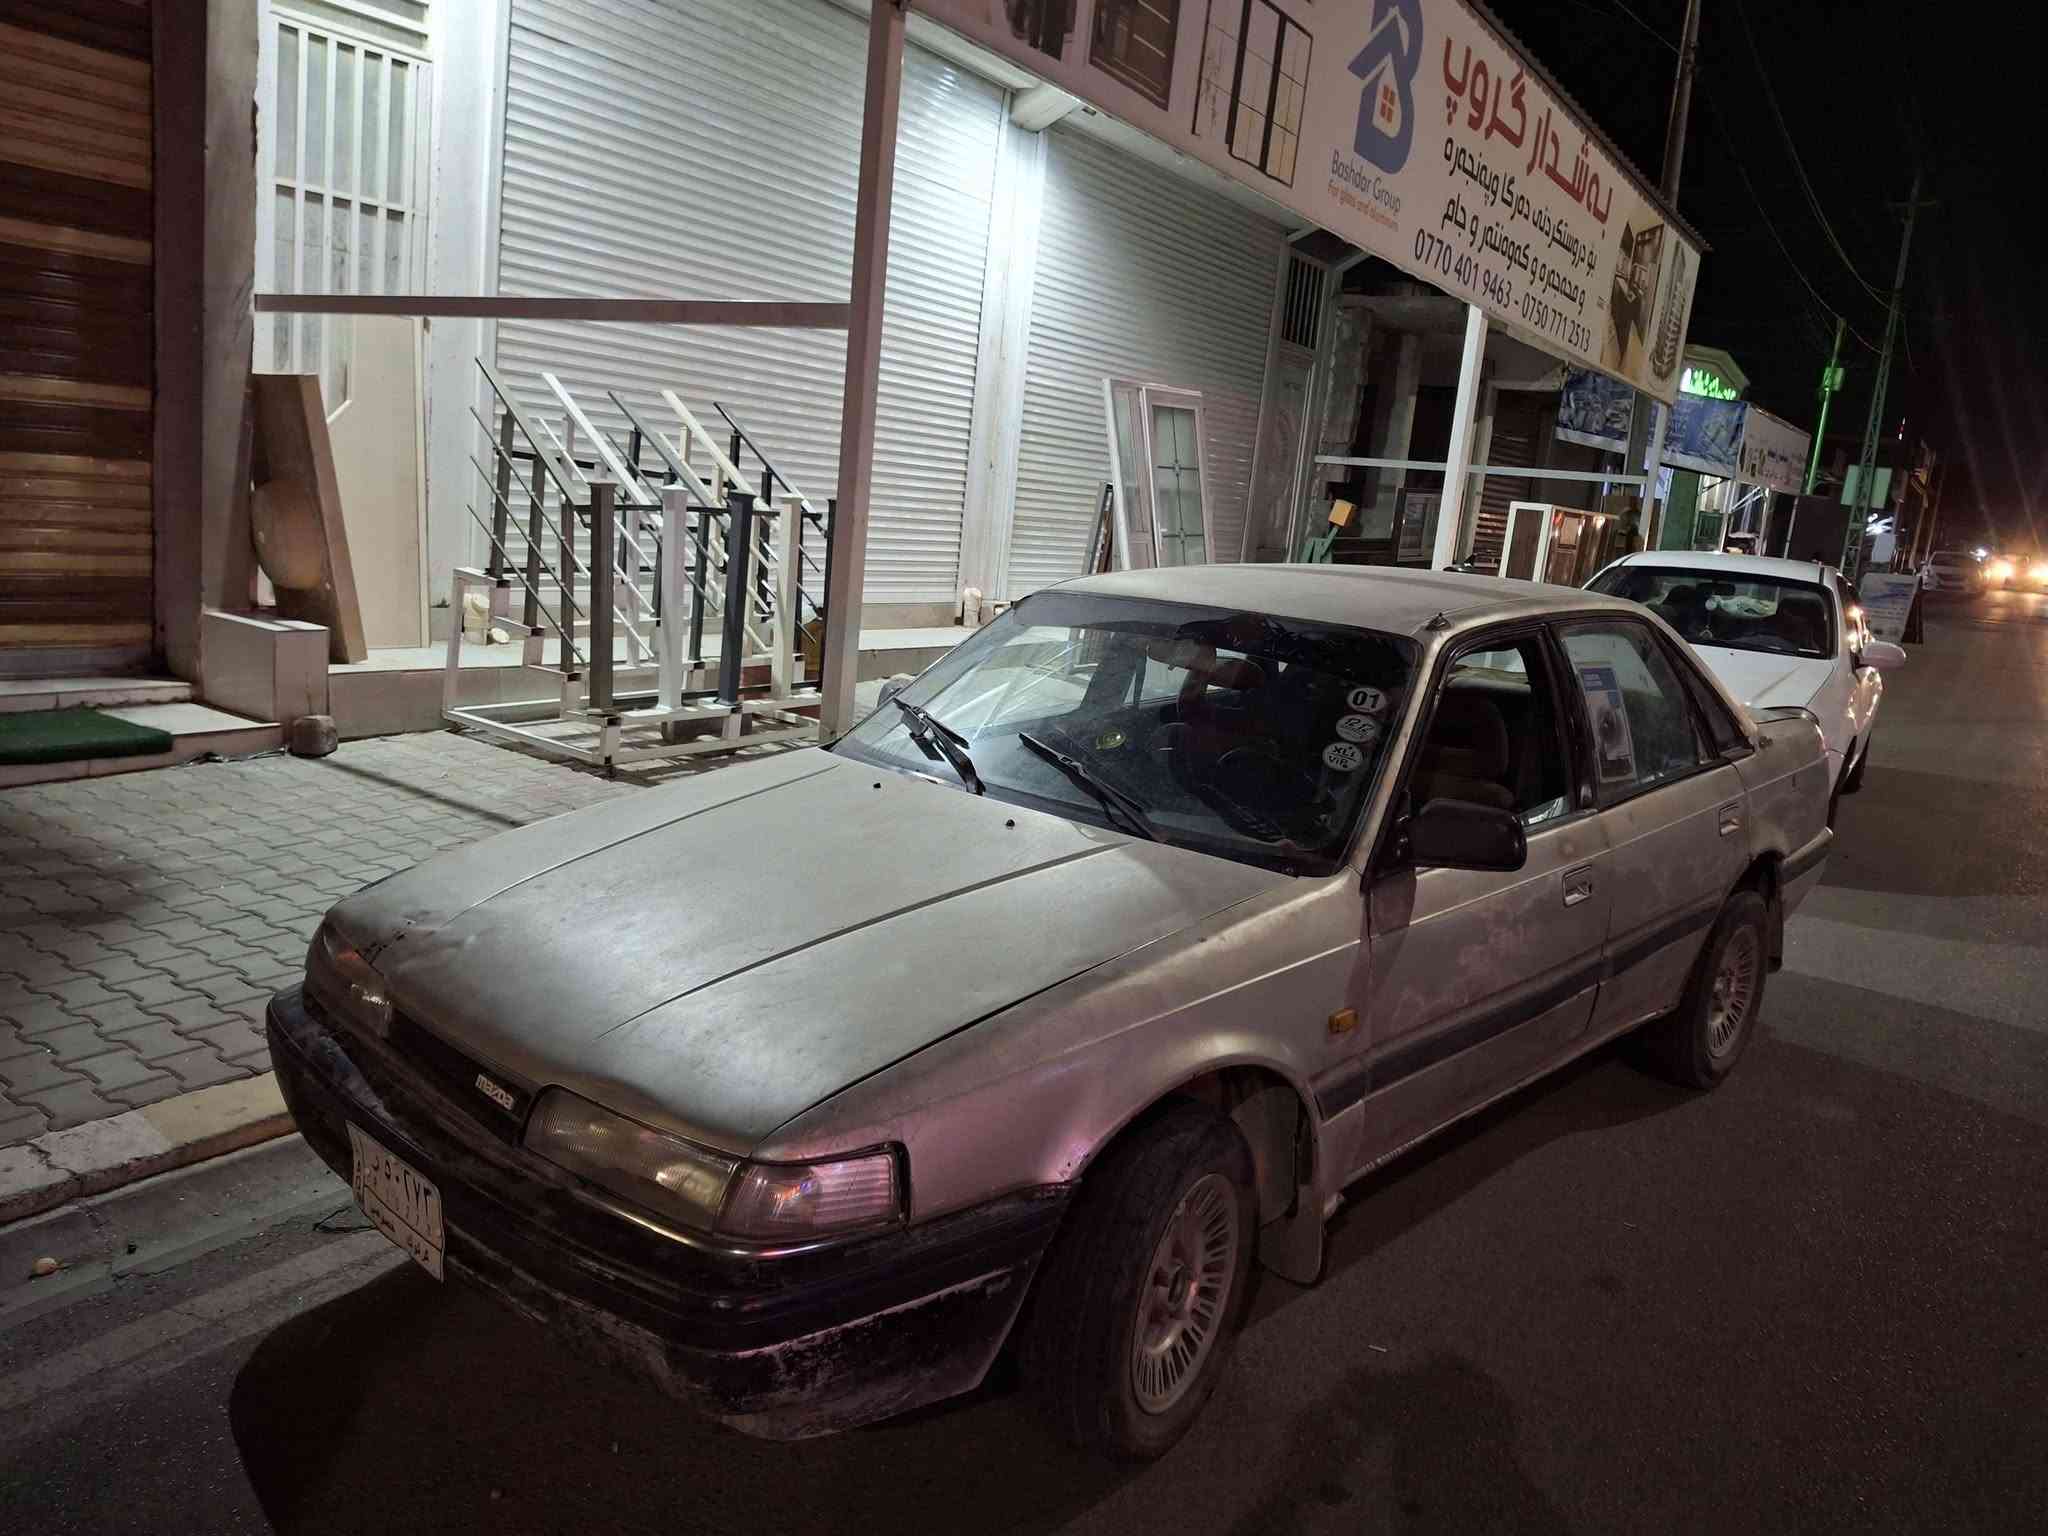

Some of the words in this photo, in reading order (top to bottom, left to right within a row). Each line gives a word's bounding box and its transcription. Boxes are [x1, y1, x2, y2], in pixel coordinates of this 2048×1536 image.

[1443, 36, 1527, 149] گروپ
[1331, 149, 1372, 193] Bashdar
[1373, 177, 1401, 217] Group
[1441, 193, 1467, 238] جام
[1414, 228, 1452, 276] 0770
[1454, 252, 1479, 291] 401
[1482, 268, 1512, 309] 9463
[1521, 292, 1549, 330] 0750
[1549, 308, 1568, 342] 771
[1568, 320, 1591, 352] 2513
[1352, 690, 1380, 709] 01
[474, 1073, 515, 1111] mazda
